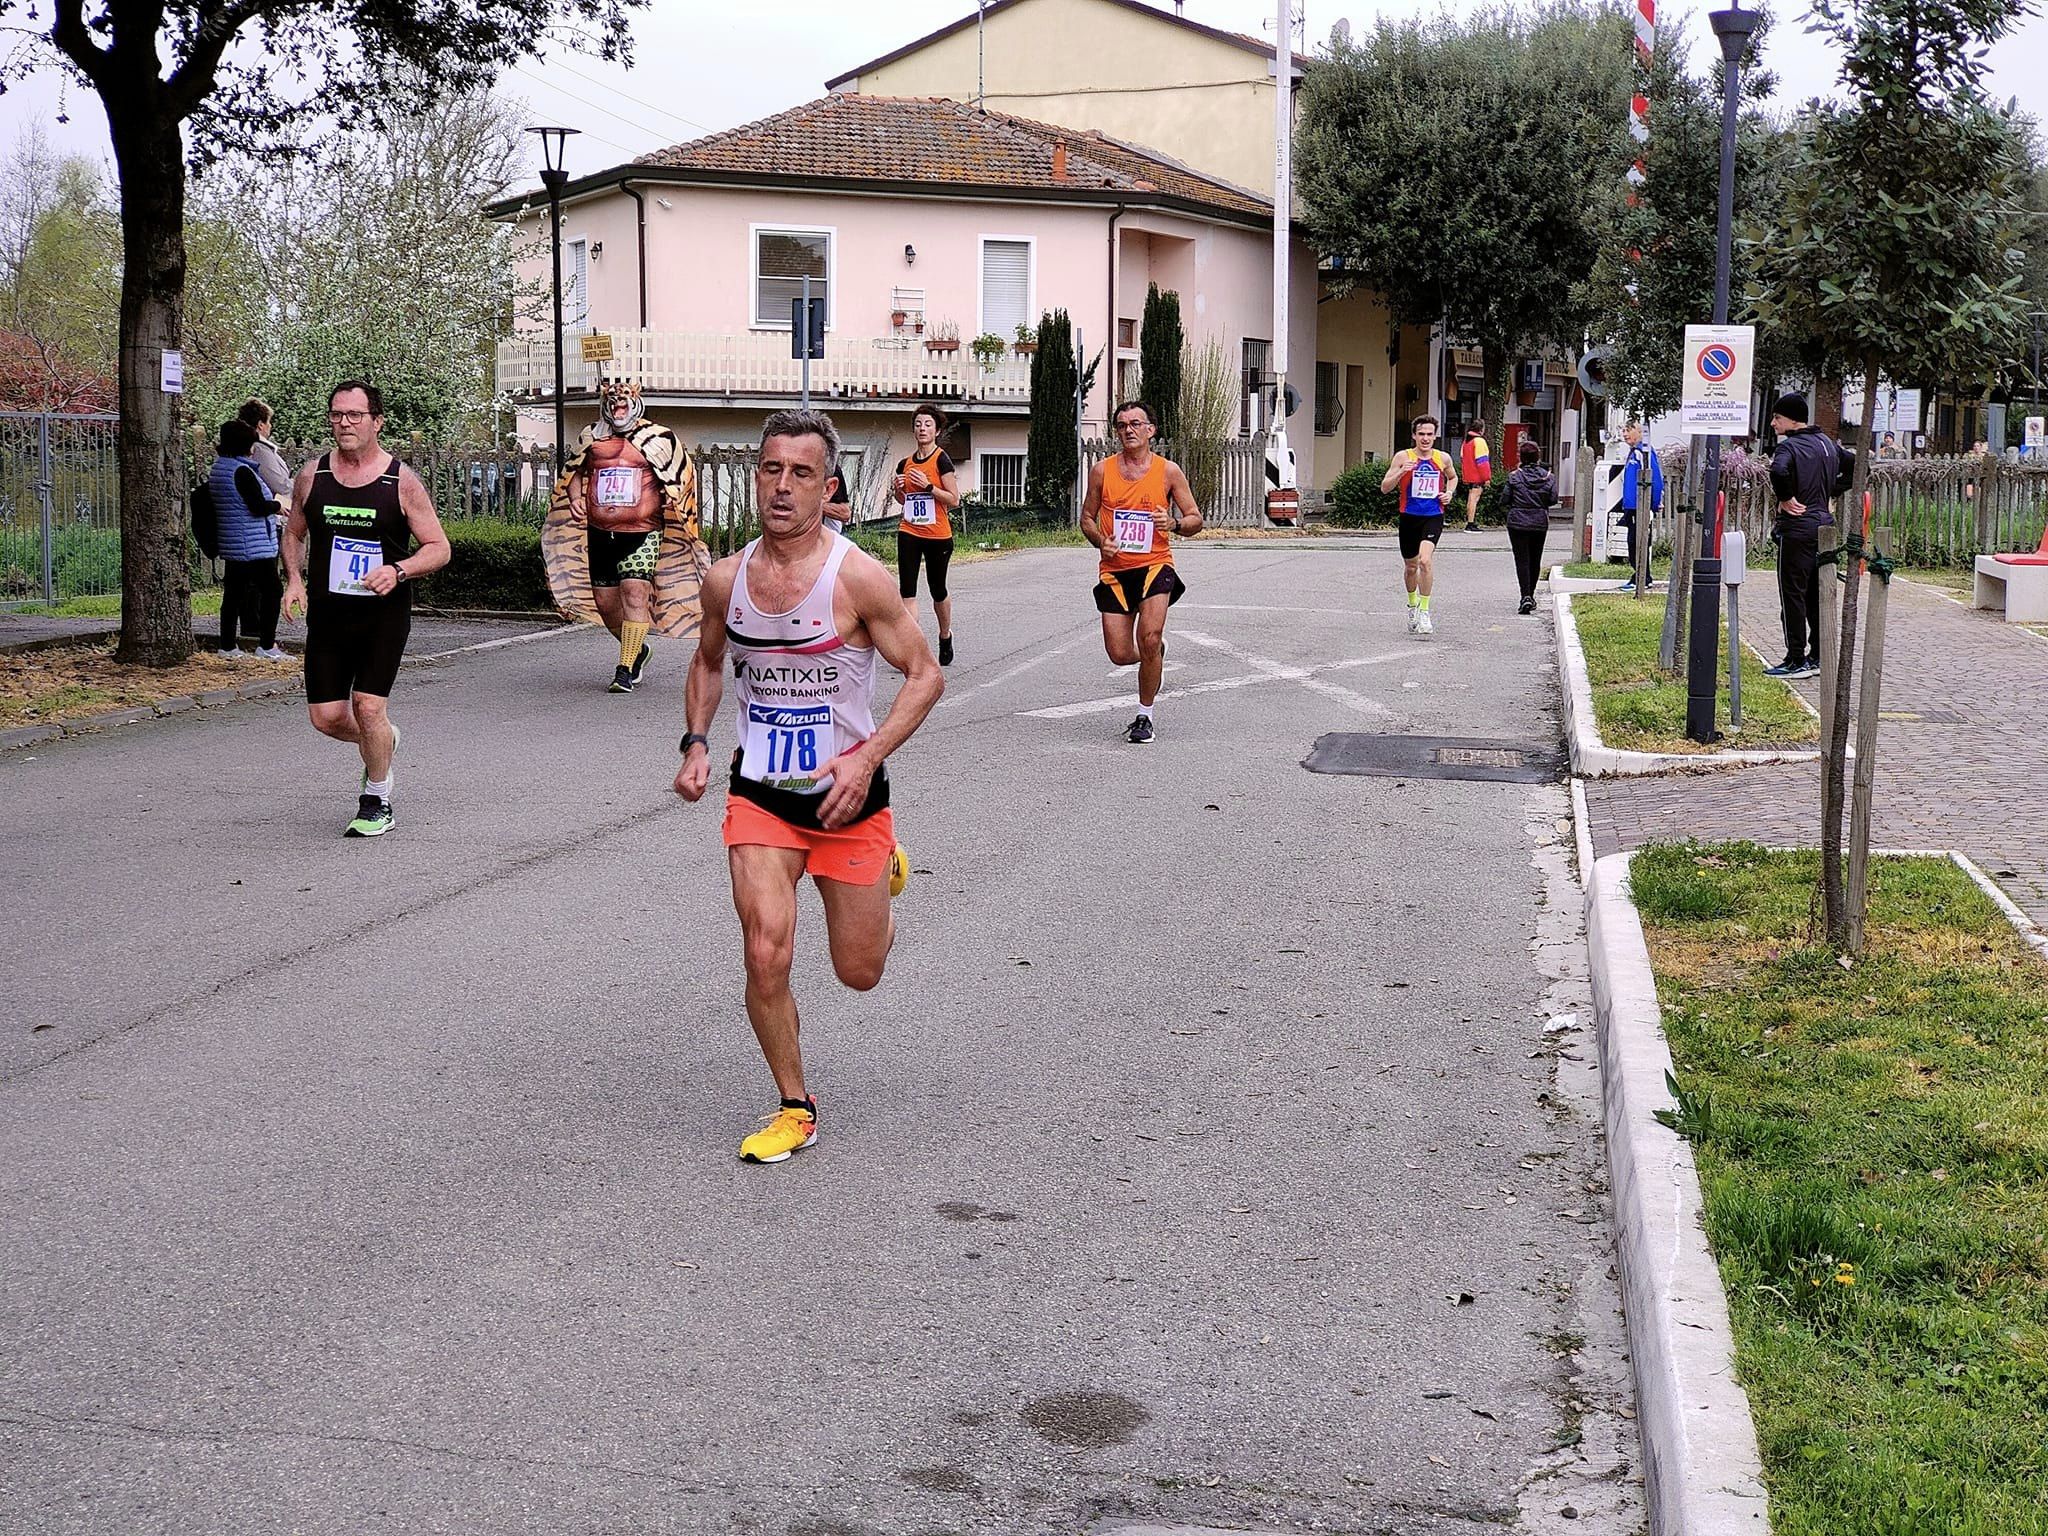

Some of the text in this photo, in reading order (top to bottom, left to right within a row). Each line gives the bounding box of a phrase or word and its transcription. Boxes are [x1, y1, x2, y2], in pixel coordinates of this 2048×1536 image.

[1460, 352, 1482, 365] TABACC
[605, 477, 627, 493] 247
[1418, 478, 1435, 491] 274
[913, 501, 926, 516] 88
[1120, 521, 1146, 542] 238
[348, 553, 370, 581] 41
[749, 666, 839, 684] NATIXIS
[750, 684, 840, 698] BEYOND BANKING
[767, 728, 817, 774] 178
